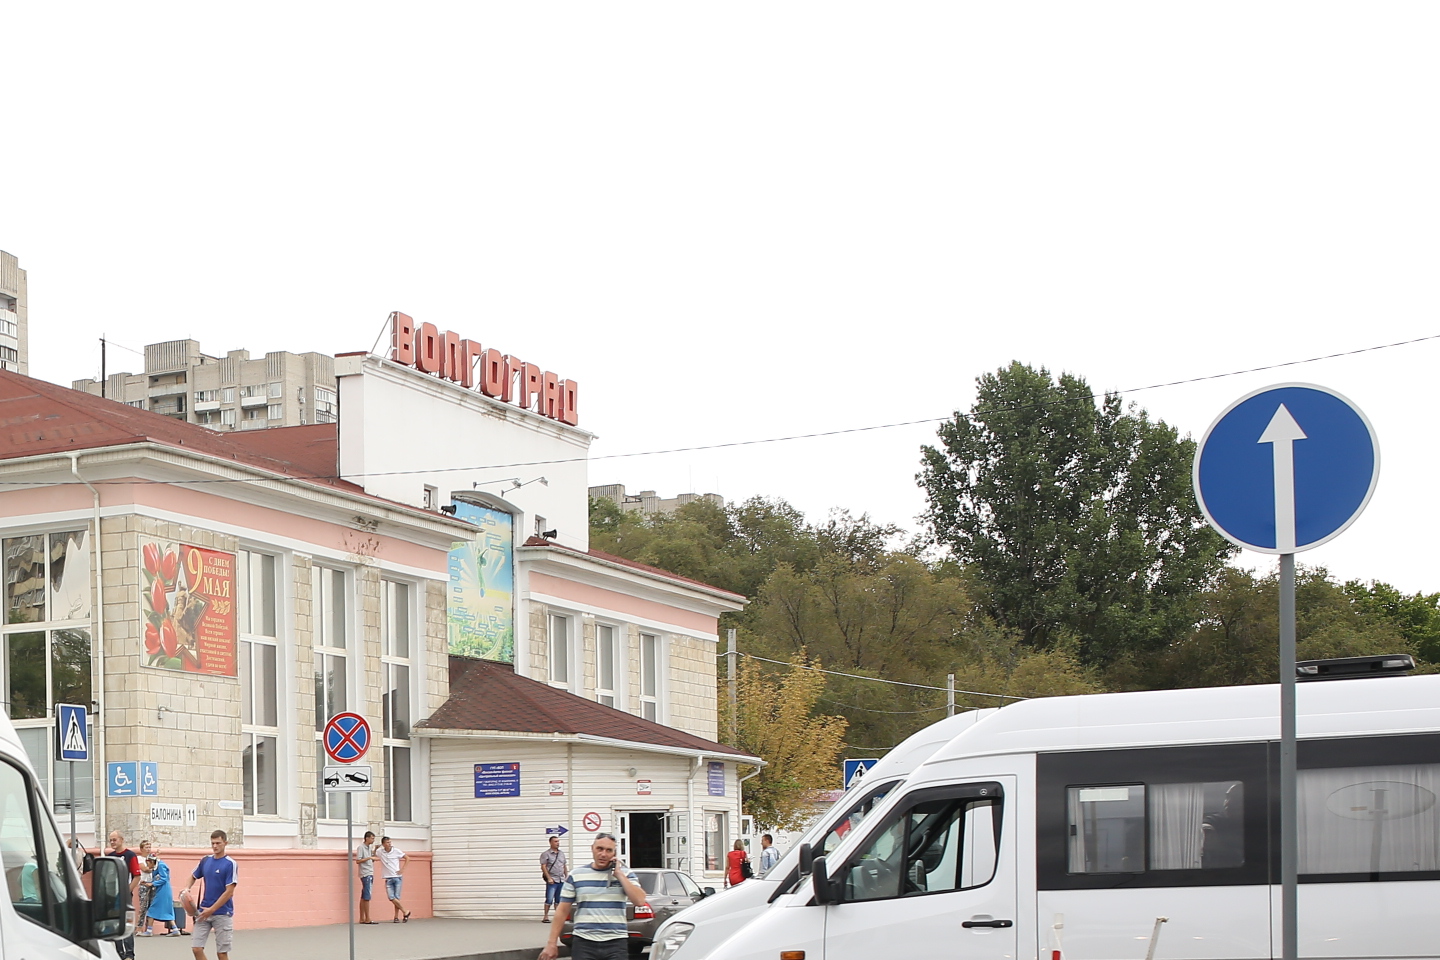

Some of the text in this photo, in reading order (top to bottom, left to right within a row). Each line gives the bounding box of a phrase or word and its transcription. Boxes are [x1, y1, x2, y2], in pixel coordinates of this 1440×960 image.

[391, 311, 578, 427] ВОЛГОГРАД
[187, 548, 203, 594] 9
[203, 565, 230, 577] ПОБЕДЫ!
[203, 576, 230, 598] МАЯ
[151, 807, 196, 822] БАЛОНИНА 11
